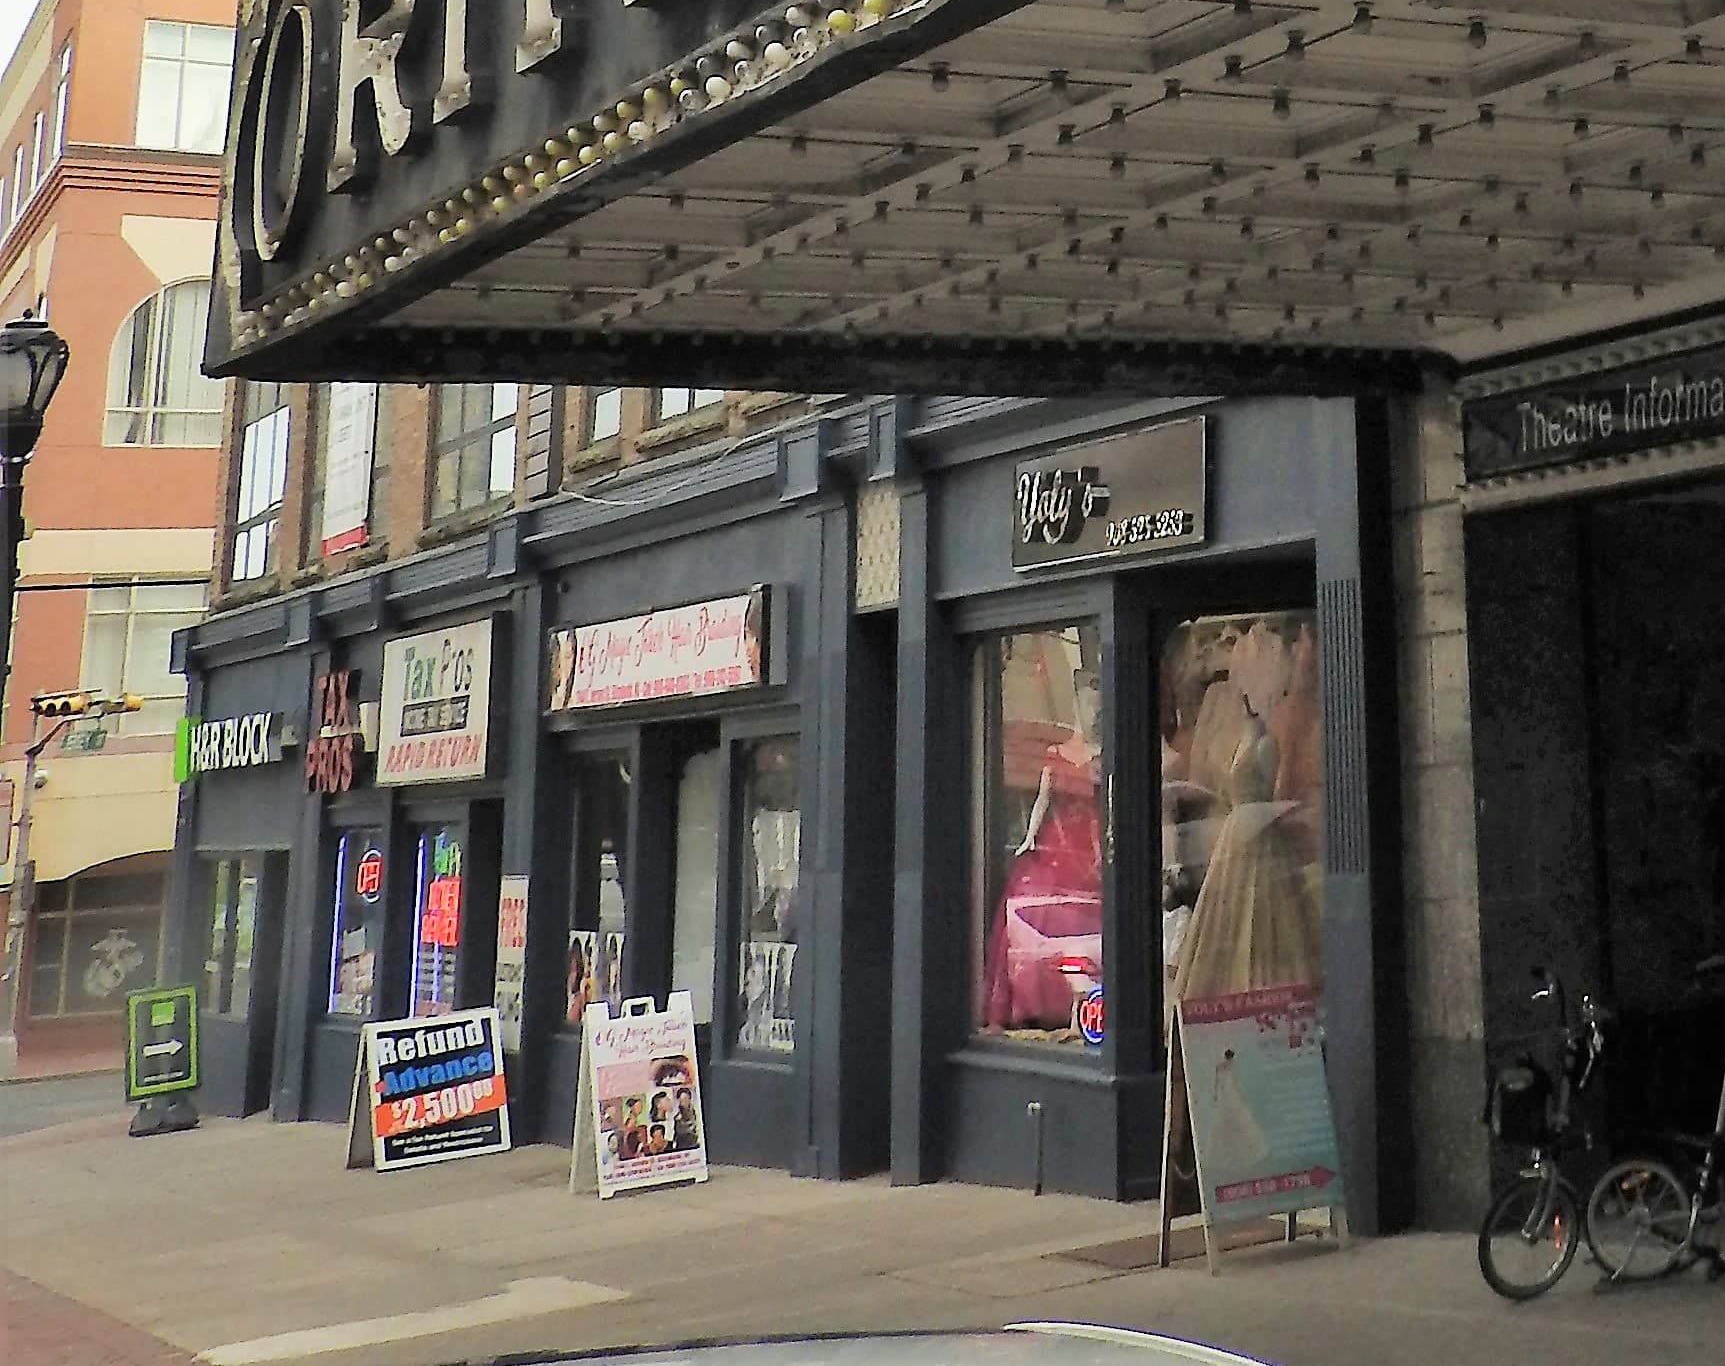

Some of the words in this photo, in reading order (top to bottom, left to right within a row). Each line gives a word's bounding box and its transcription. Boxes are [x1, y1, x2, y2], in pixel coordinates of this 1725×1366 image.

[1515, 400, 1612, 453] Theatre
[190, 719, 221, 772] H&R
[221, 712, 272, 768] BLOCK
[377, 1019, 485, 1066] Refund
[383, 1051, 493, 1096] Advance
